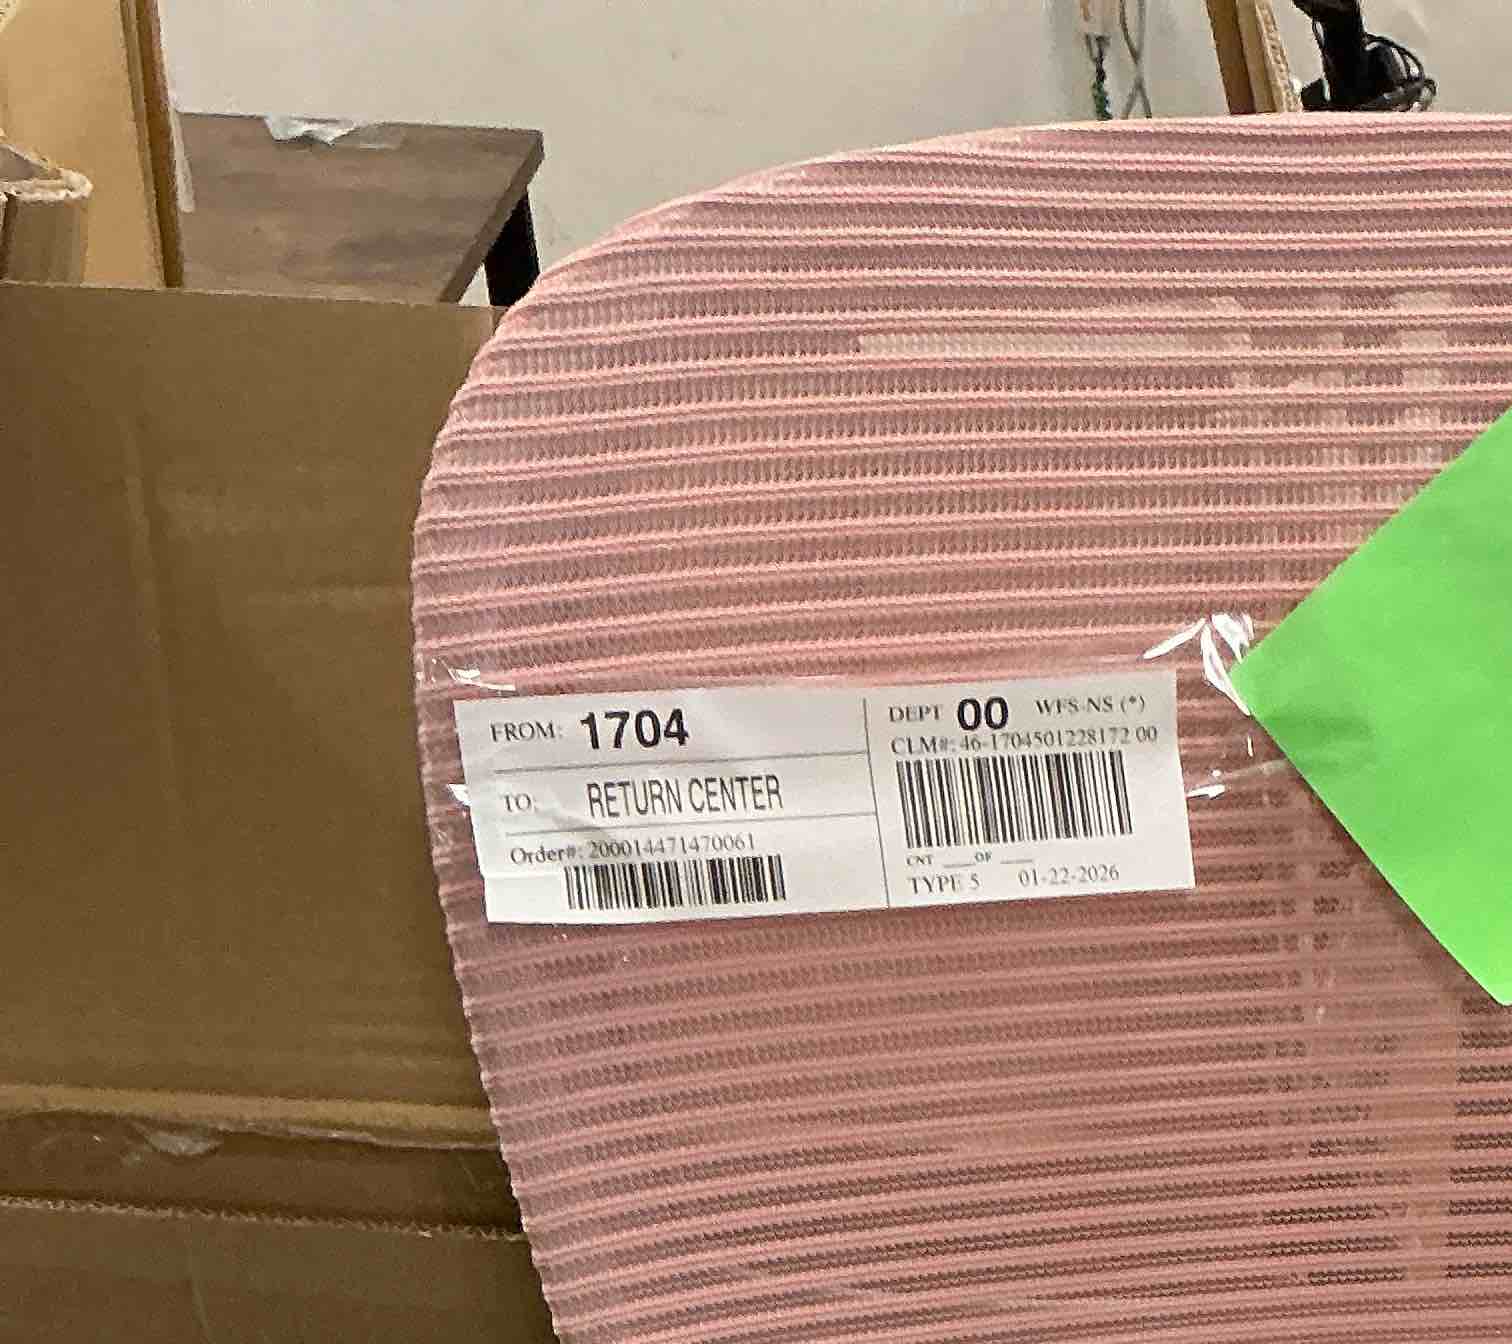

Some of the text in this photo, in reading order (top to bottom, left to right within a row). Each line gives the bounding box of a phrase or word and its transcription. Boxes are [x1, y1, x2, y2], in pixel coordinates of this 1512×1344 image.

[490, 708, 690, 750] FROM: 1704
[888, 704, 943, 722] DEPT
[957, 696, 1009, 731] 00
[502, 774, 784, 818] TO: RETURN CENTER
[510, 845, 584, 865] Order#:
[1017, 863, 1120, 888] 01-22-2026
